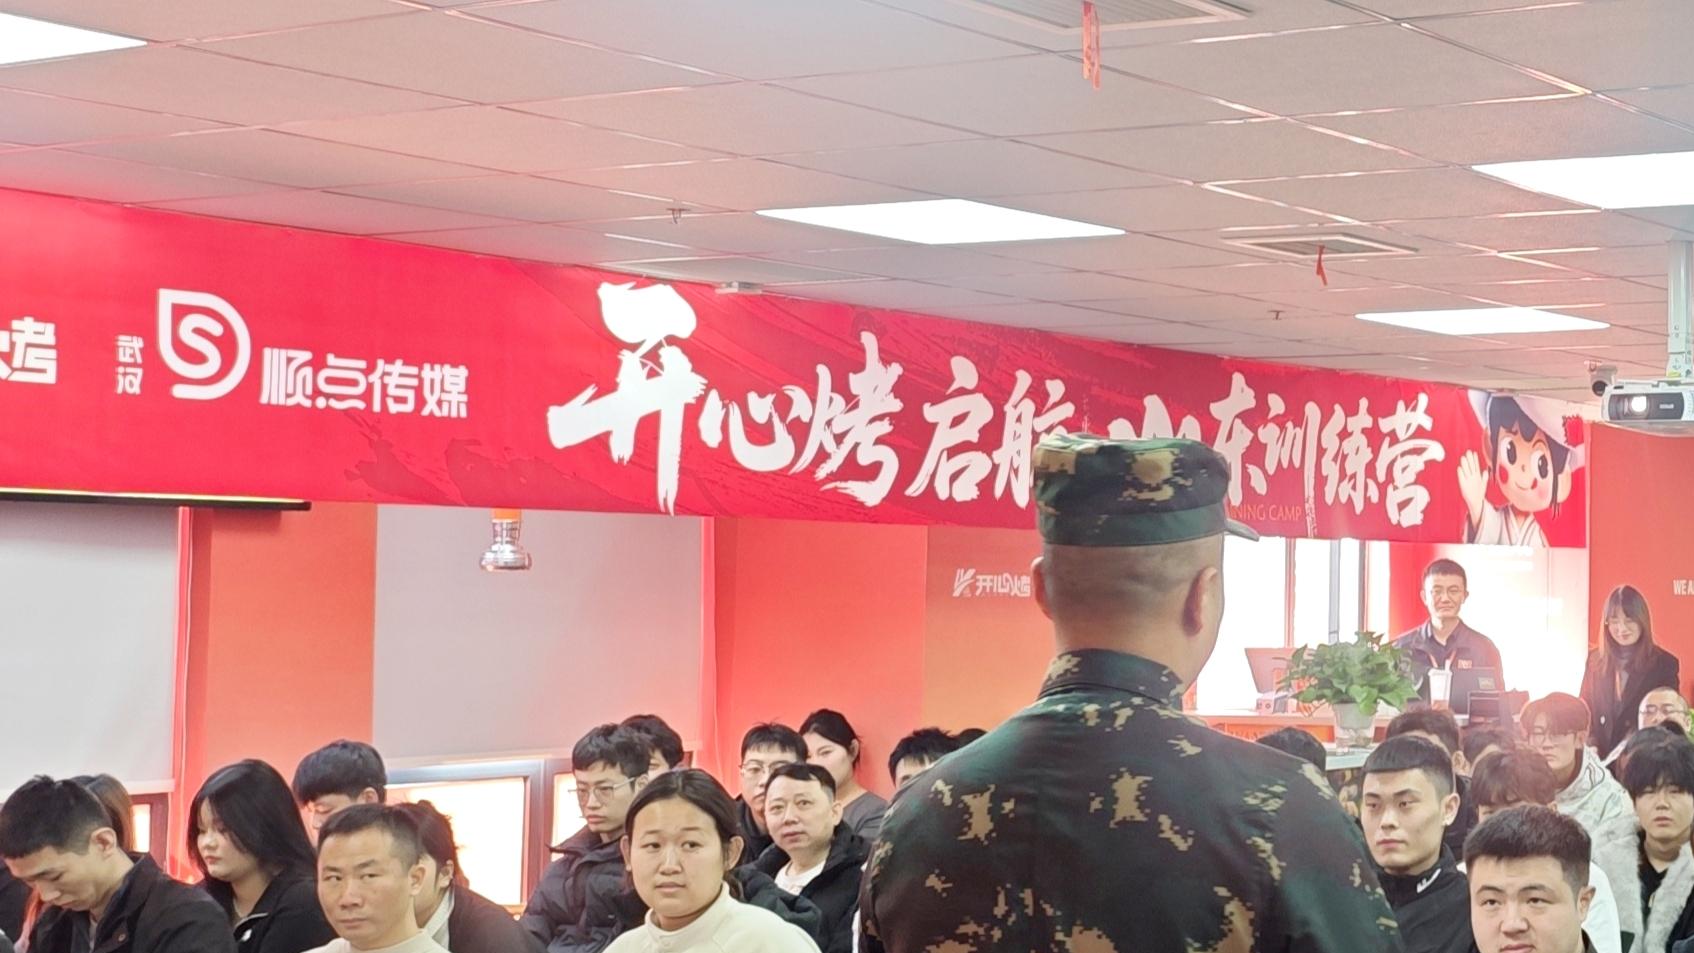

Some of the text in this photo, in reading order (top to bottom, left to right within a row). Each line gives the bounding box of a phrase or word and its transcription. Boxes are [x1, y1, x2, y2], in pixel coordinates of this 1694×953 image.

[115, 334, 145, 395] 武汉
[259, 346, 469, 418] 顺点传媒
[1268, 503, 1303, 521] CAMP
[1673, 580, 1687, 595] WE
